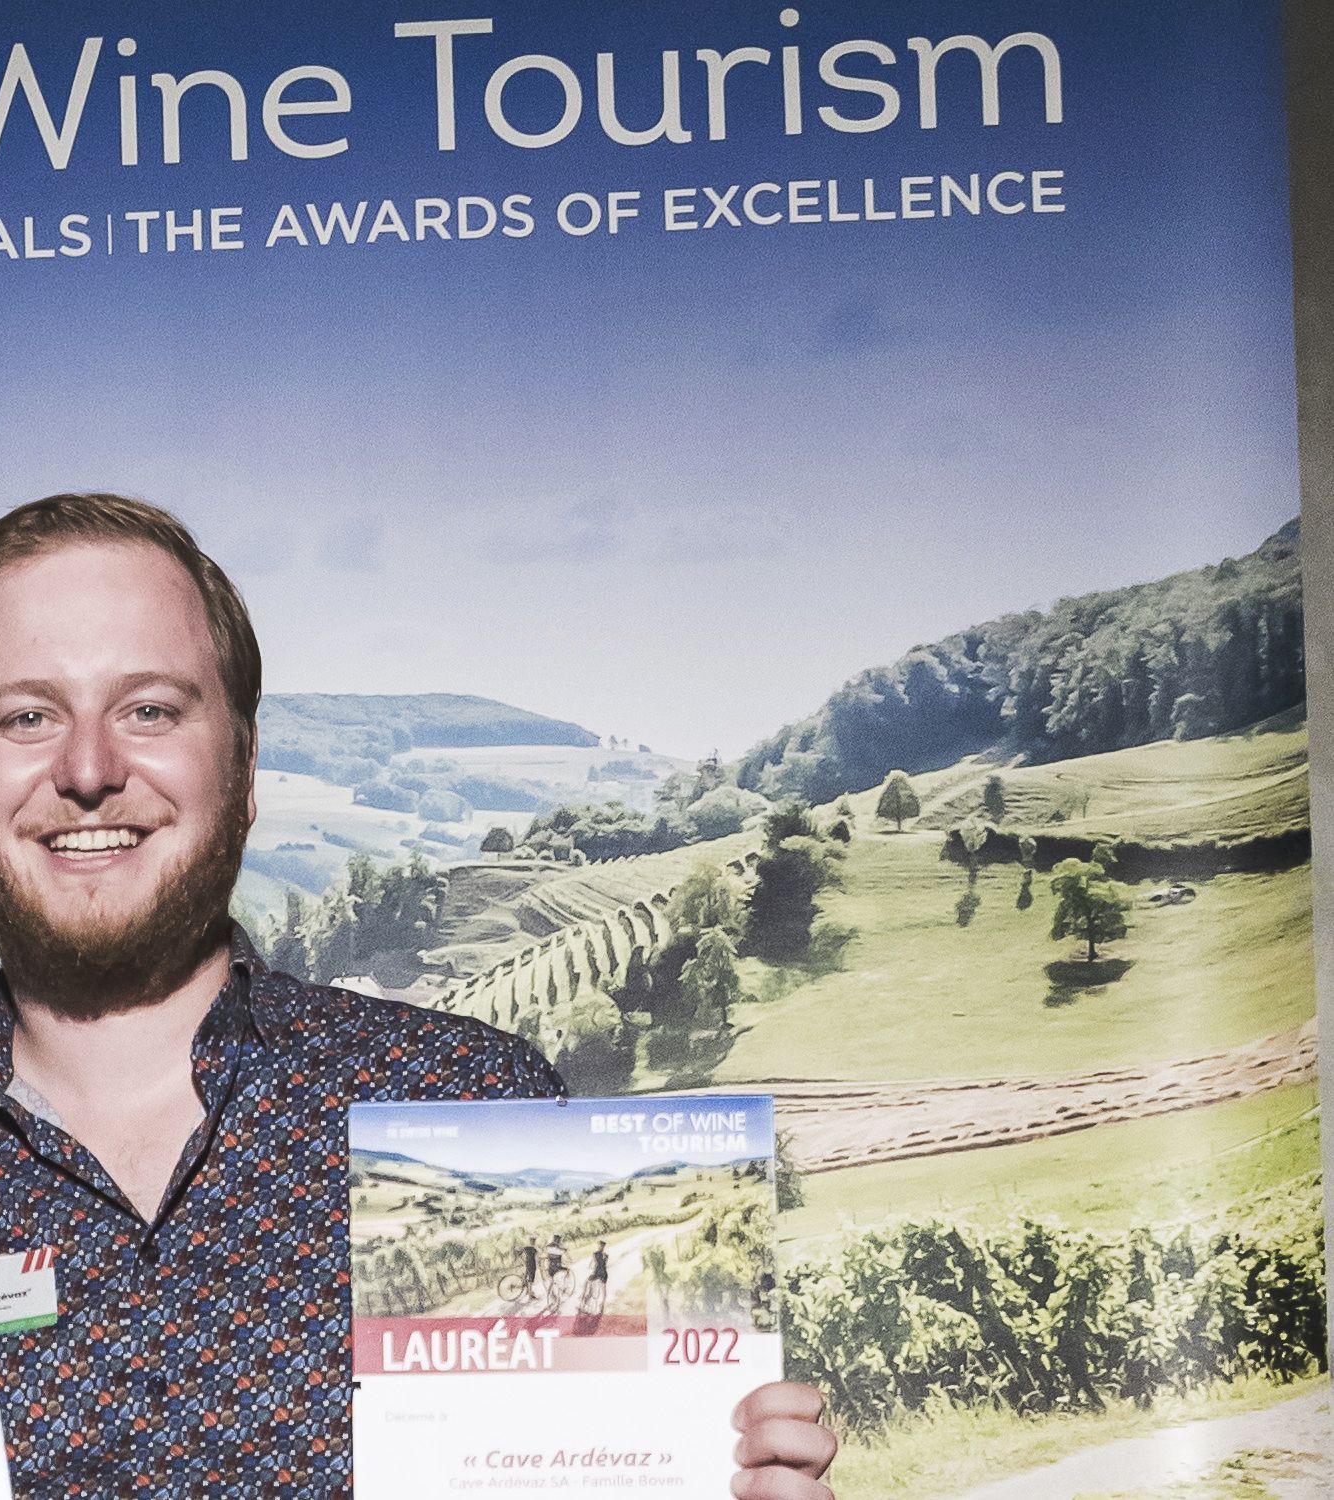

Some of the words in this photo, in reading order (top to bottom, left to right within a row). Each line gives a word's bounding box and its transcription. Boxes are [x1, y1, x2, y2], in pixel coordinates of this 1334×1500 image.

[393, 8, 1064, 152] Tourism
[124, 207, 245, 255] THE
[265, 193, 536, 249] AWARDS
[556, 191, 642, 237] OF
[664, 170, 1067, 232] EXCELLENCE
[590, 1113, 646, 1134] BEST
[652, 1112, 684, 1133] OF
[689, 1111, 747, 1132] WINE
[638, 1133, 747, 1153] TOURISM
[382, 1318, 560, 1372] LAURÉAT
[662, 1326, 741, 1366] 2022
[485, 1450, 543, 1469] Cave
[549, 1447, 652, 1468] Ardévaz
[449, 1476, 485, 1490] Cave
[487, 1475, 547, 1489] Ardévaz
[550, 1475, 570, 1488] SA
[581, 1473, 634, 1488] Famille
[639, 1474, 684, 1487] Boven
